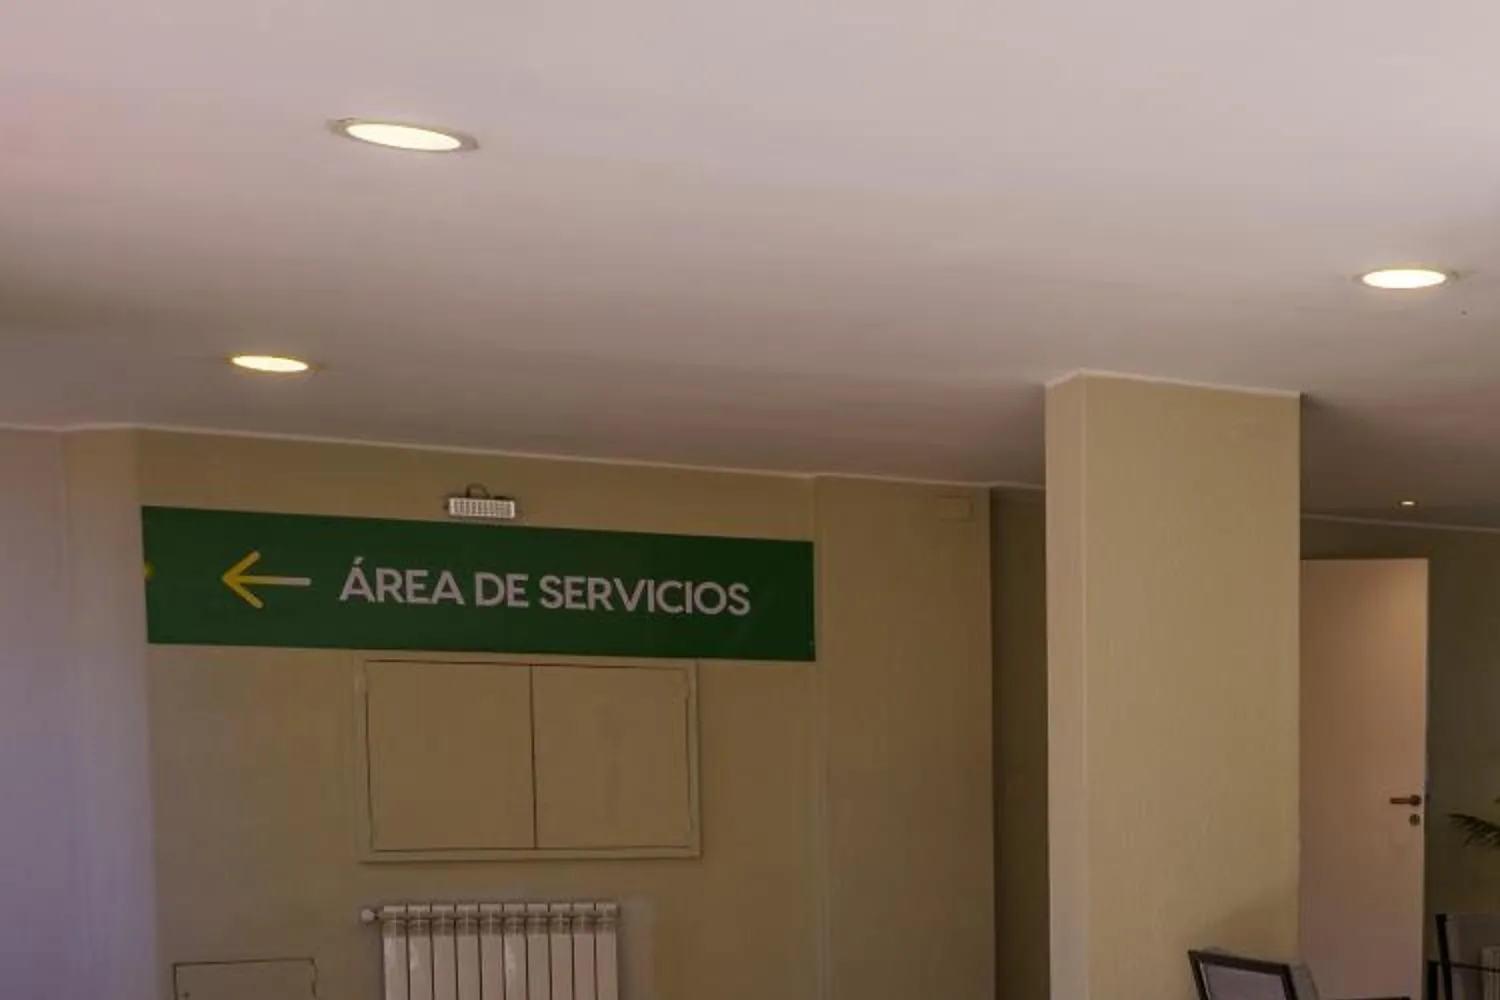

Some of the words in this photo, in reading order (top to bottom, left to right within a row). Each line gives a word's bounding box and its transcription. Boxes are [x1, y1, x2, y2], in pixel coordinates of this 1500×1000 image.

[338, 555, 465, 605] ÁREA
[475, 571, 529, 608] DE
[539, 574, 751, 616] SERVICIOS
